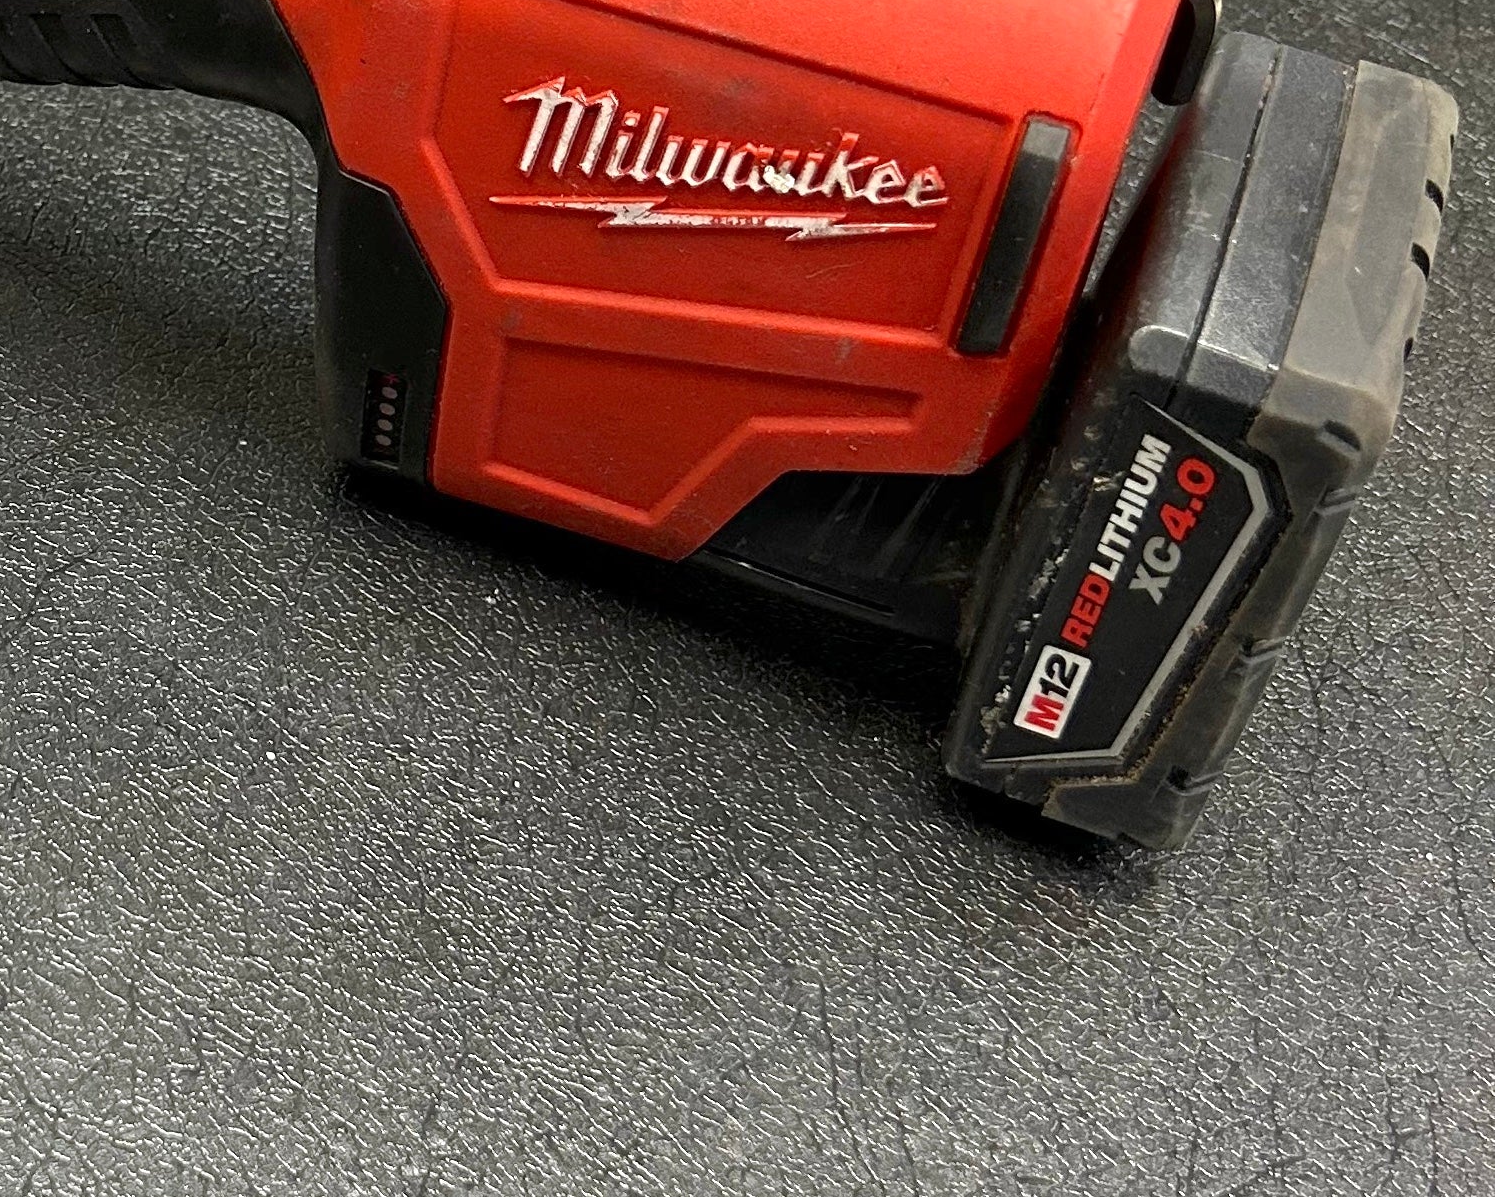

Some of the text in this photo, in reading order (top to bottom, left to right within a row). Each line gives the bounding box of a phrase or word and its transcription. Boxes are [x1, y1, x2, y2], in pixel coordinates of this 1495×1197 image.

[503, 76, 949, 208] Milwaukee
[1024, 434, 1172, 731] M12 REDLITHIUM
